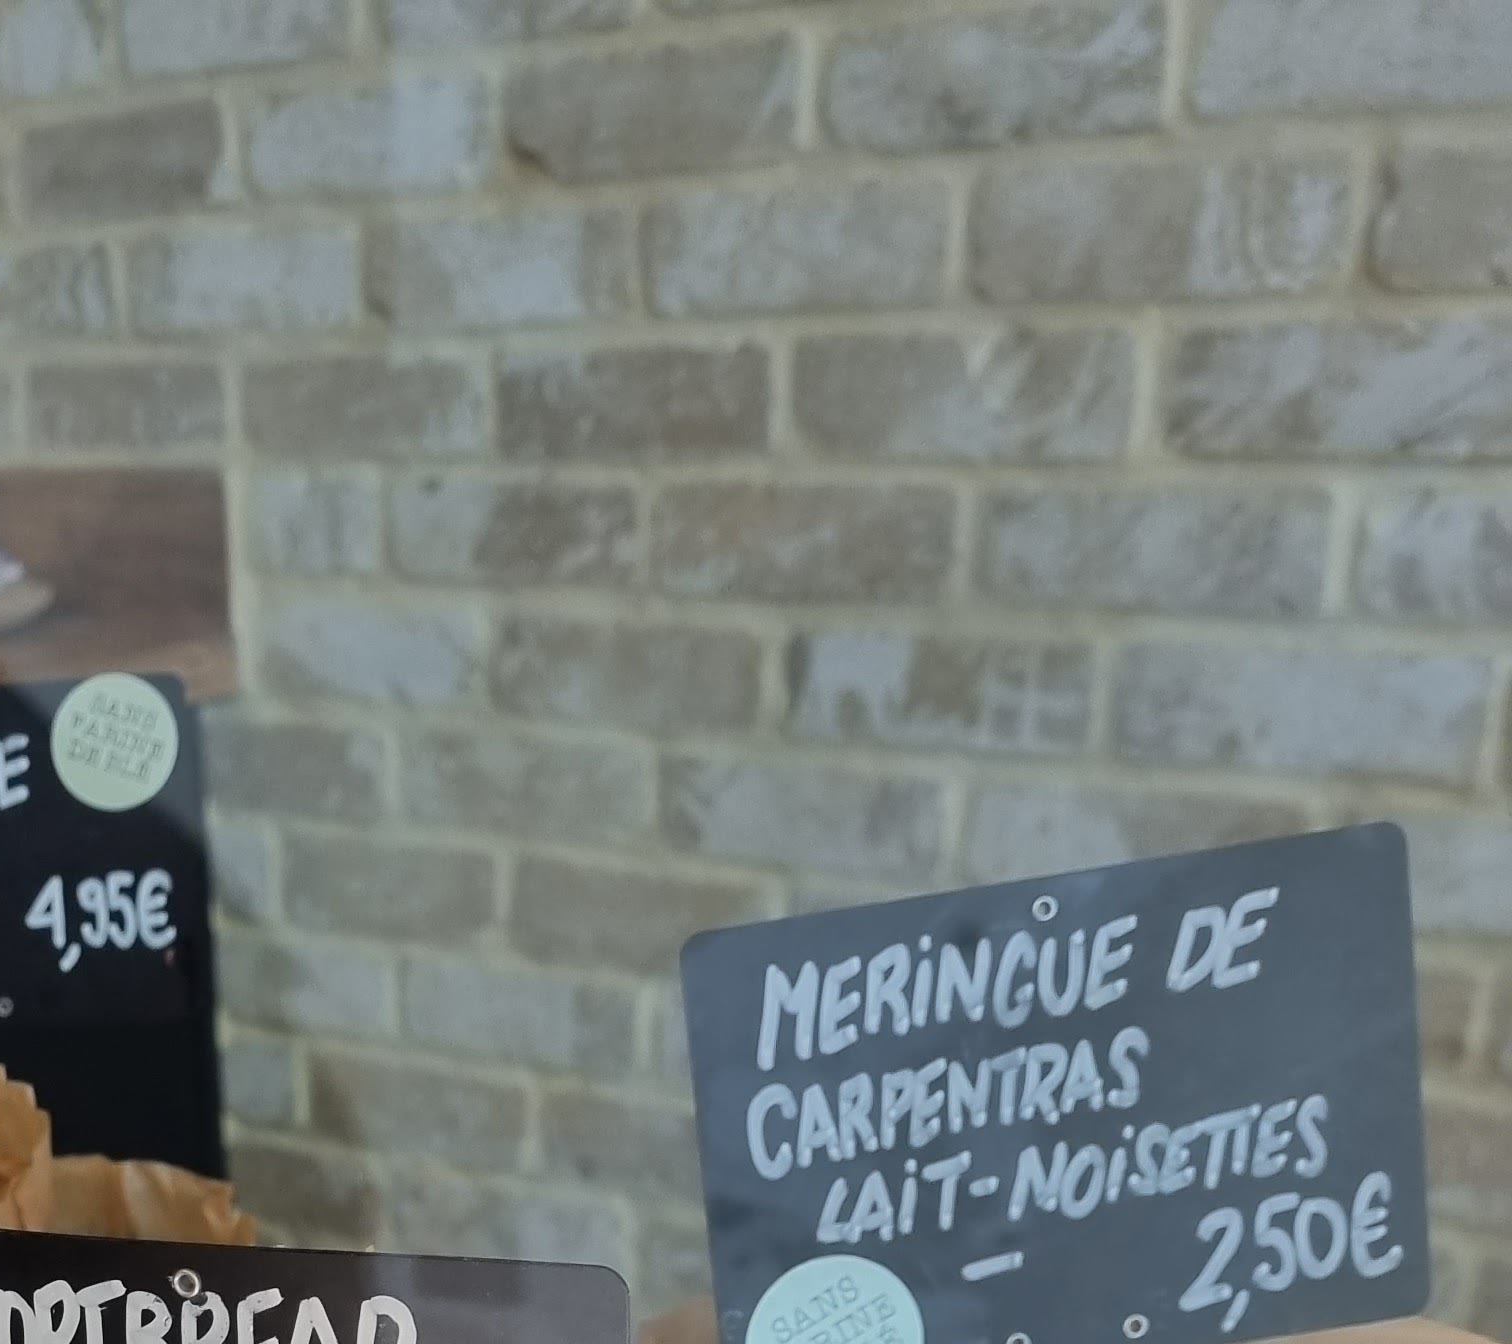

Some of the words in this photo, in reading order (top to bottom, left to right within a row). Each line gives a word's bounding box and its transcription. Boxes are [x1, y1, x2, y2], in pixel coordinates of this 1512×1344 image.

[26, 869, 176, 972] 4,95€
[1168, 887, 1280, 992] DE
[748, 1027, 1149, 1180] CARPENTRAS
[1179, 1171, 1403, 1333] 2,50€
[772, 1275, 859, 1344] SANS
